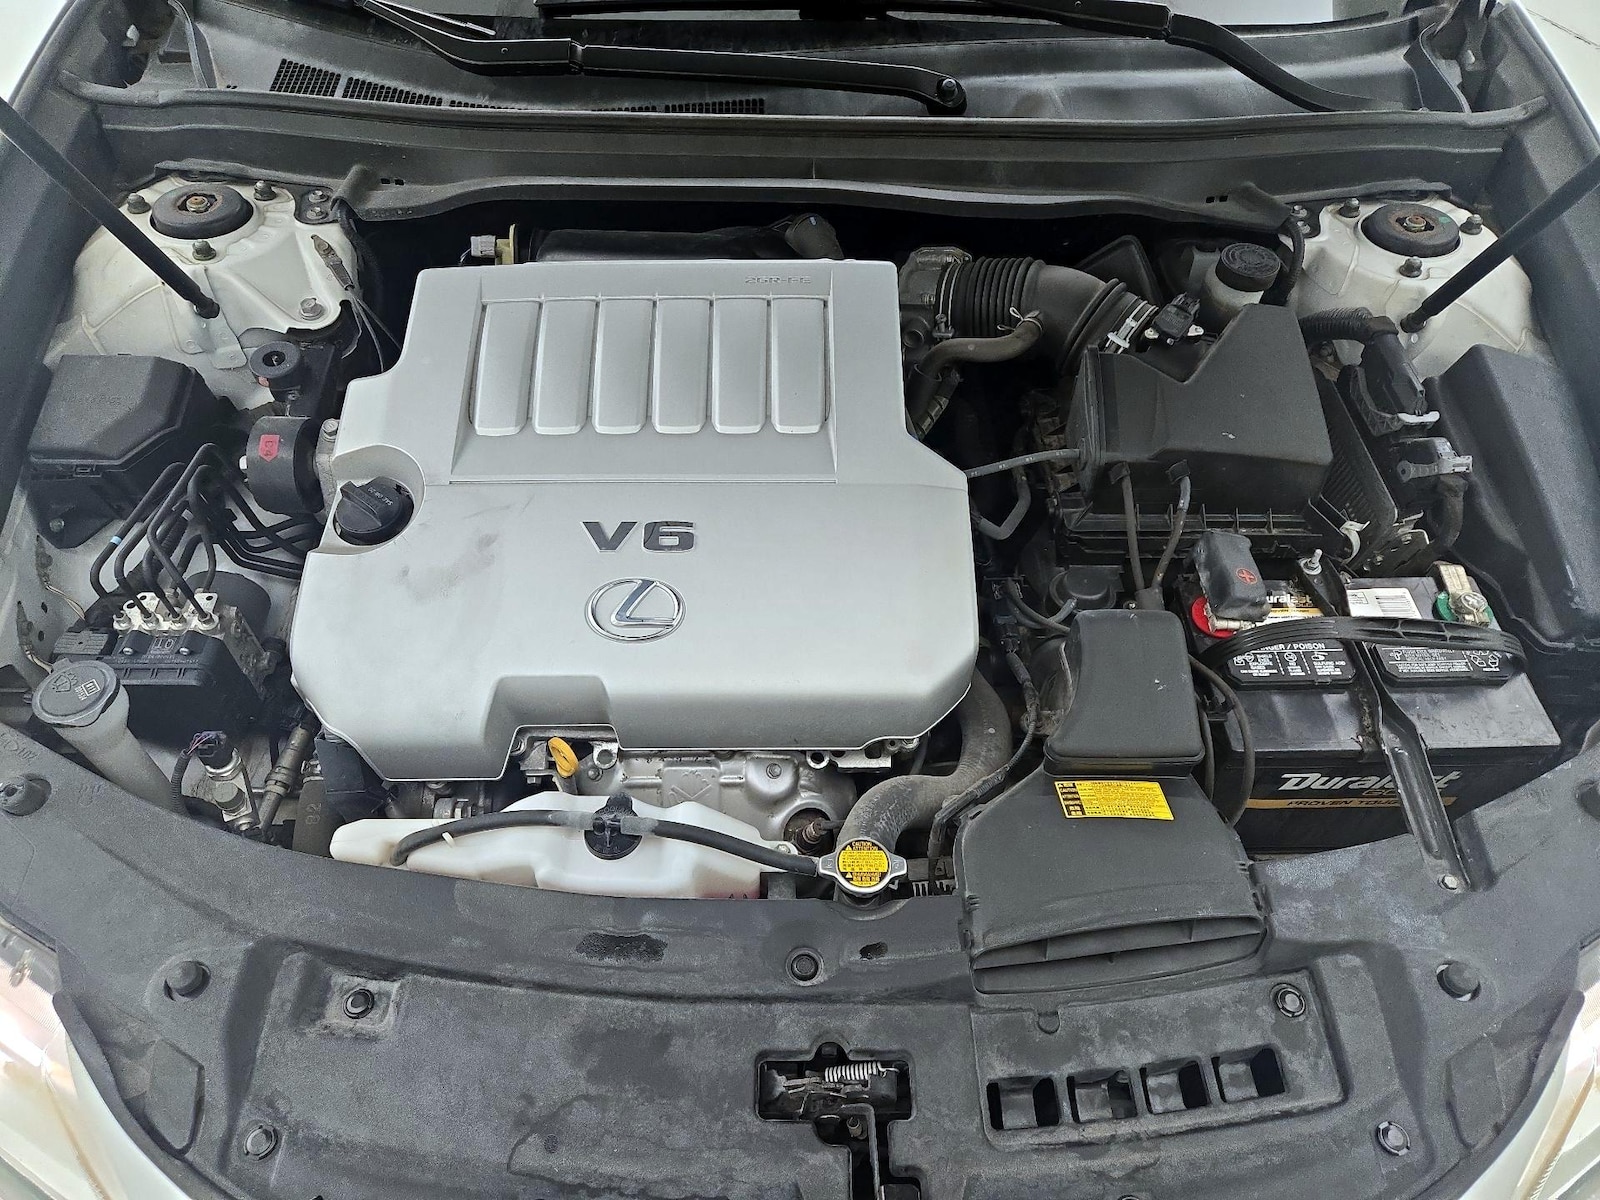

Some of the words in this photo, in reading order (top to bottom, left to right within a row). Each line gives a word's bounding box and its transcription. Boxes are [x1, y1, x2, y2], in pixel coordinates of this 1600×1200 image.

[581, 521, 696, 553] V6
[1266, 593, 1313, 604] uralast
[1278, 771, 1462, 791] Duralt
[1287, 799, 1352, 807] PROVEN
